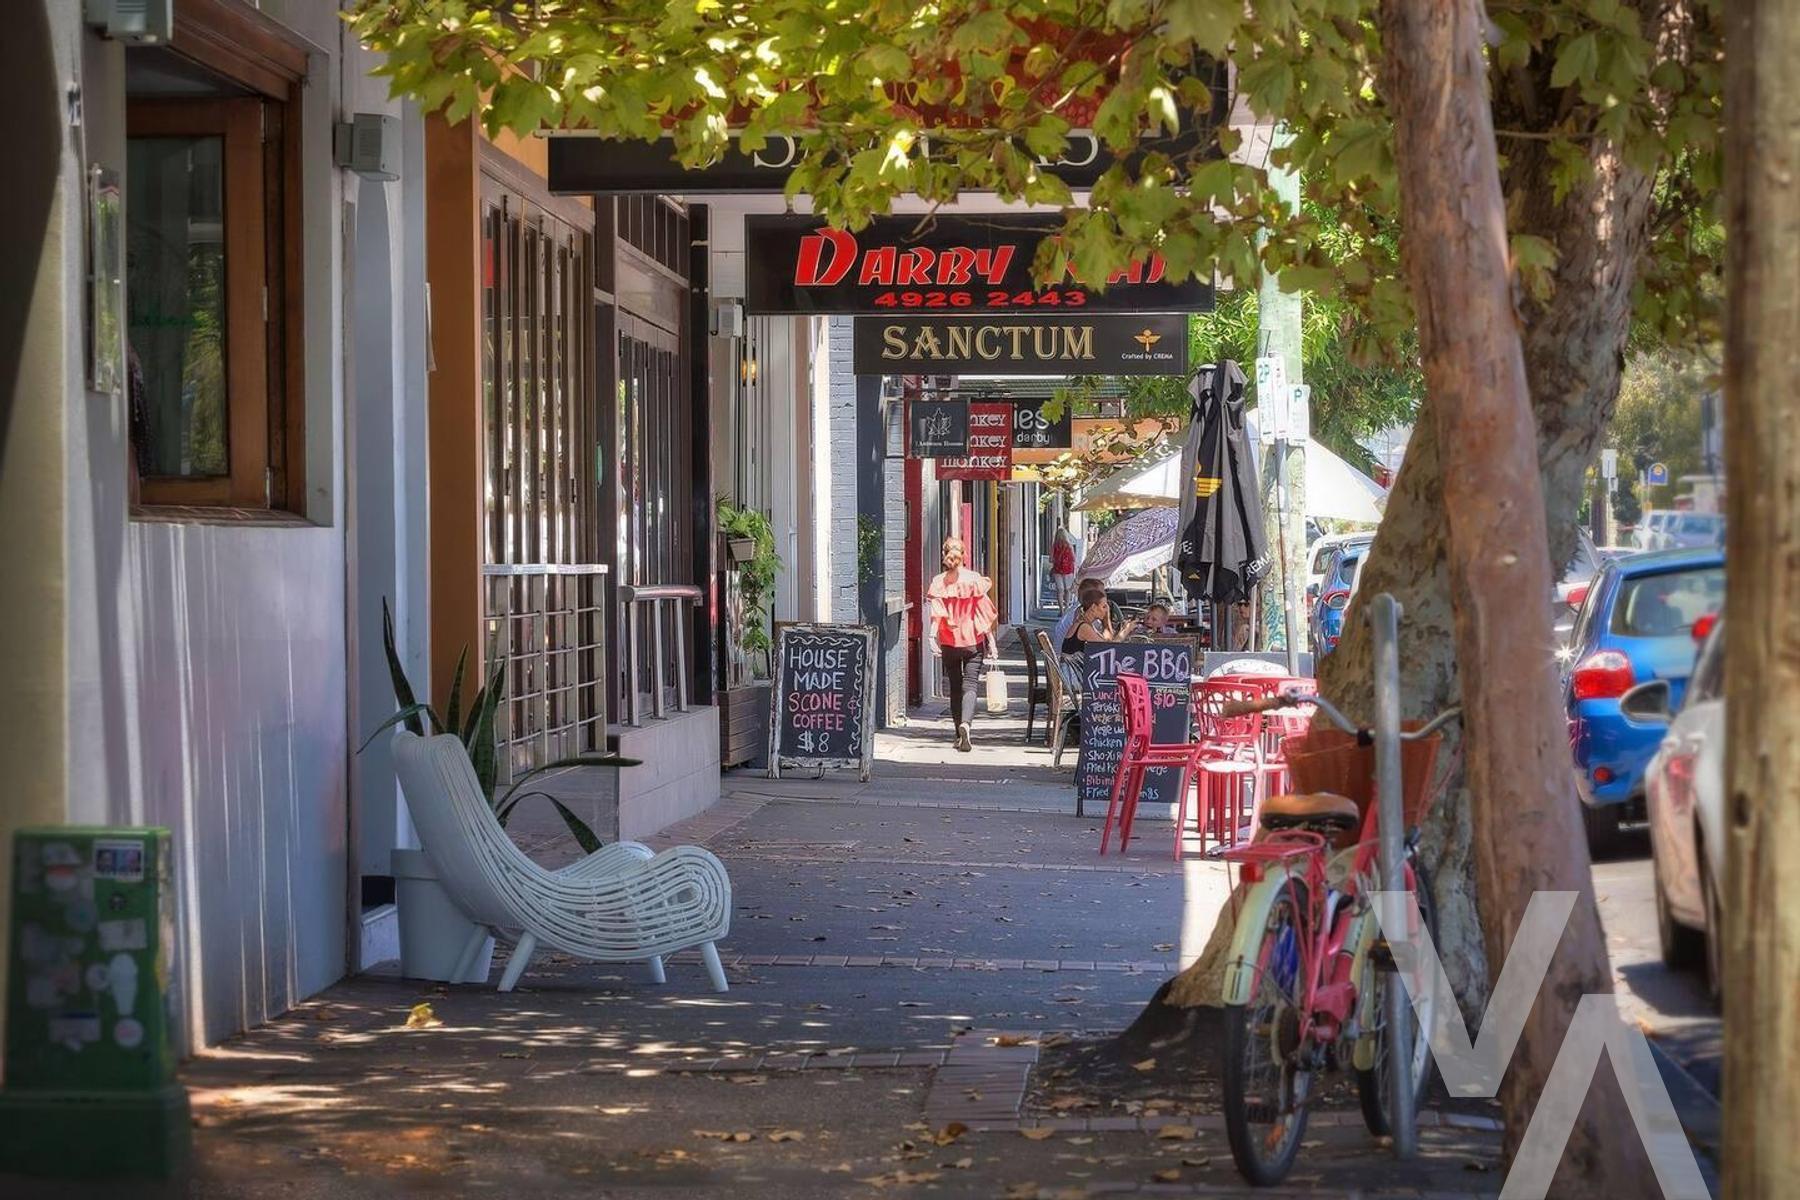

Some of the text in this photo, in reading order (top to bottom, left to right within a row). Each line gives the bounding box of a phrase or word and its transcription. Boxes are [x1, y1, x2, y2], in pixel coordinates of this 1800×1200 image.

[794, 228, 1016, 286] DARBY
[874, 292, 1087, 308] 4926 2443
[880, 325, 1097, 361] SANCTUM
[1121, 352, 1144, 360] Crafted
[790, 647, 849, 669] HOUSE
[1089, 648, 1190, 682] The BBQ
[794, 672, 846, 690] MADE
[788, 692, 844, 713] SCONE
[792, 714, 846, 732] COFFEE
[797, 731, 830, 754] $8
